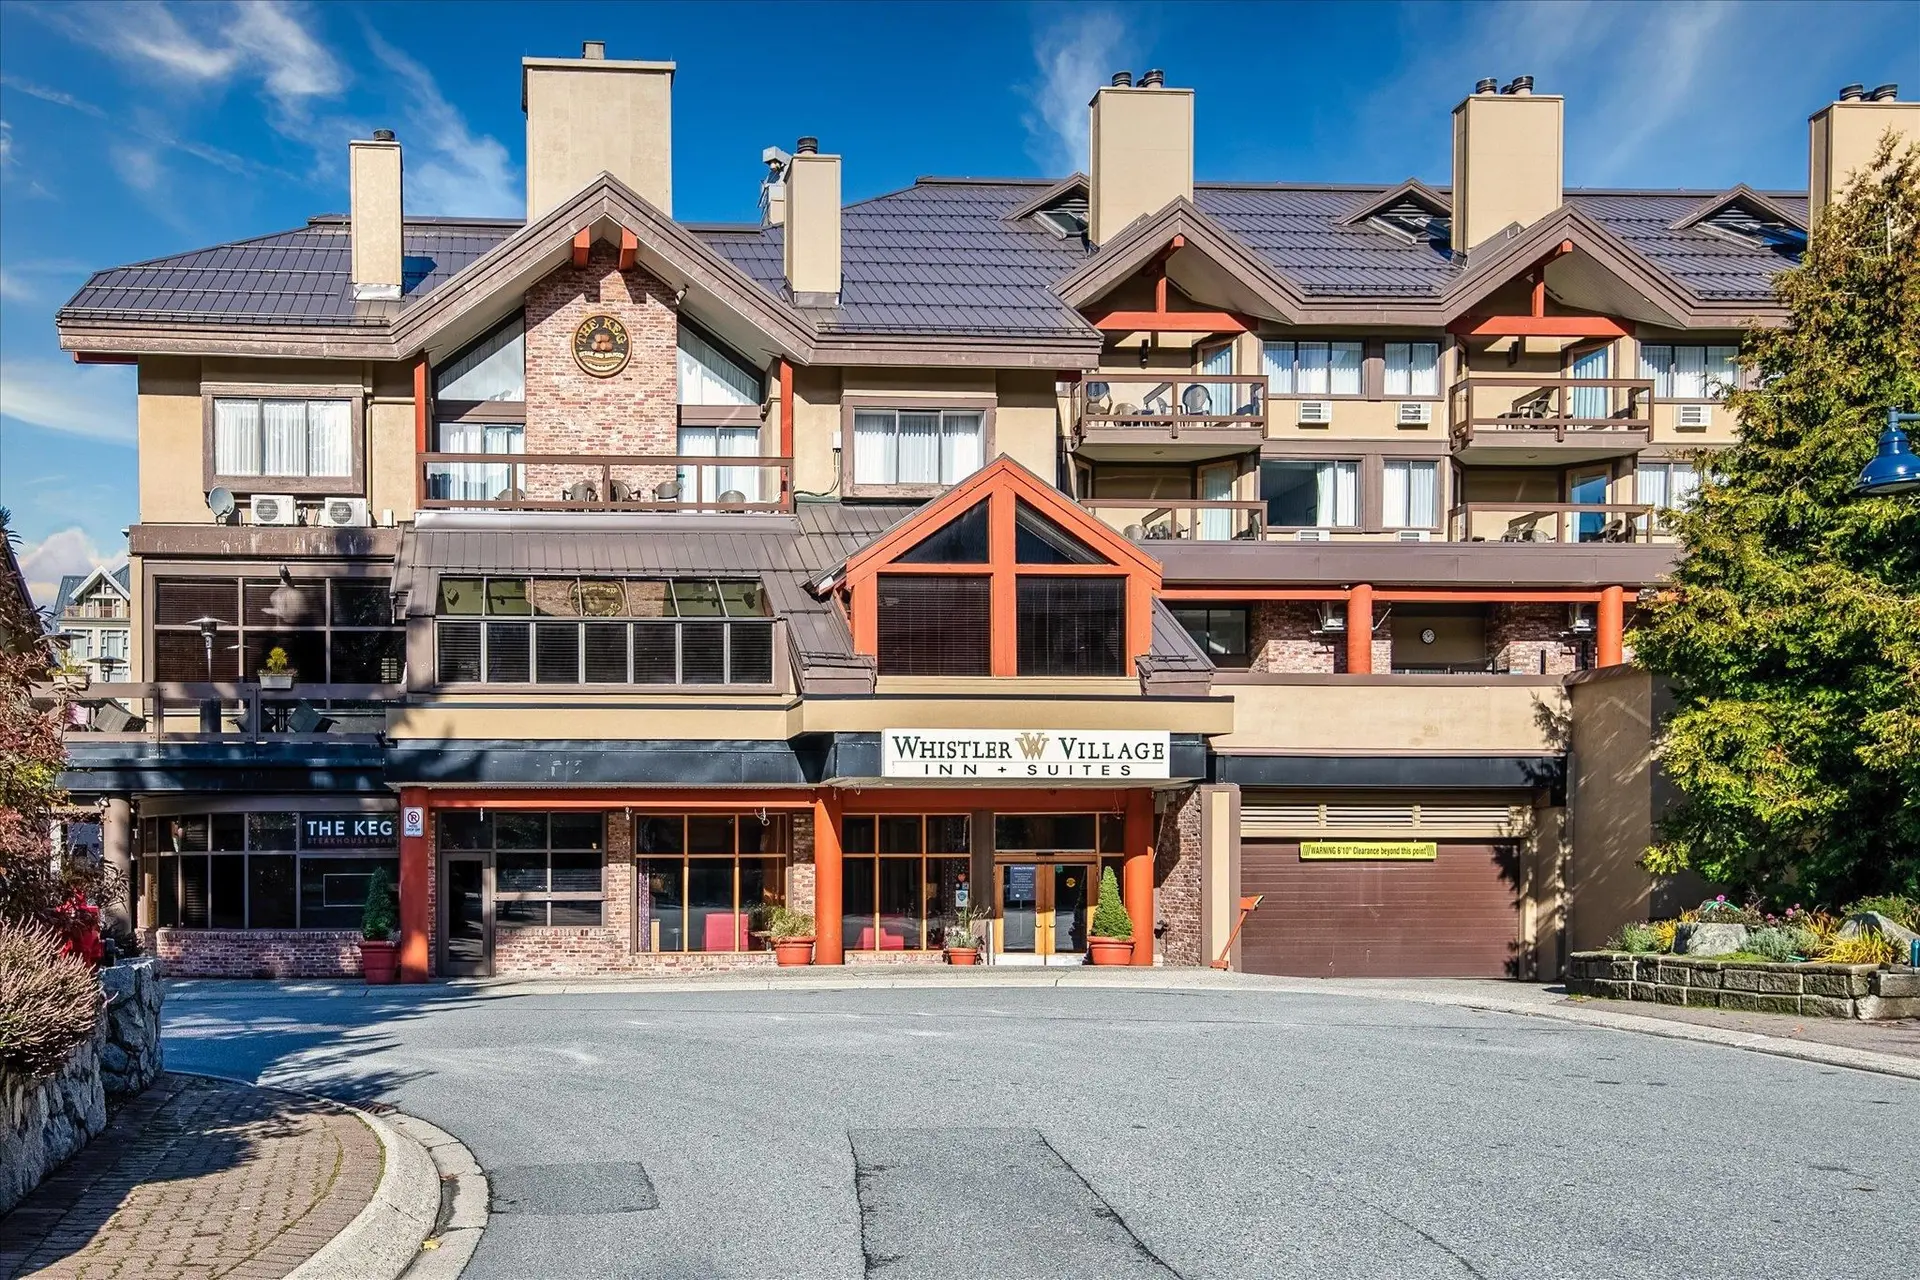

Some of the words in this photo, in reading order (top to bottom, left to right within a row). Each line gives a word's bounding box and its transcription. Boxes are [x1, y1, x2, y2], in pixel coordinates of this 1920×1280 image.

[576, 319, 599, 345] THE
[603, 318, 627, 344] KEG
[924, 764, 977, 775] INN
[1027, 764, 1131, 776] SUITES
[307, 820, 345, 836] THE
[354, 820, 393, 836] KEG
[307, 837, 369, 845] STEAKHOUSE
[1311, 846, 1336, 855] WARNING
[1353, 846, 1379, 855] Clearance
[1380, 846, 1400, 857] beyond
[1401, 846, 1411, 855] this
[1412, 846, 1426, 857] point
